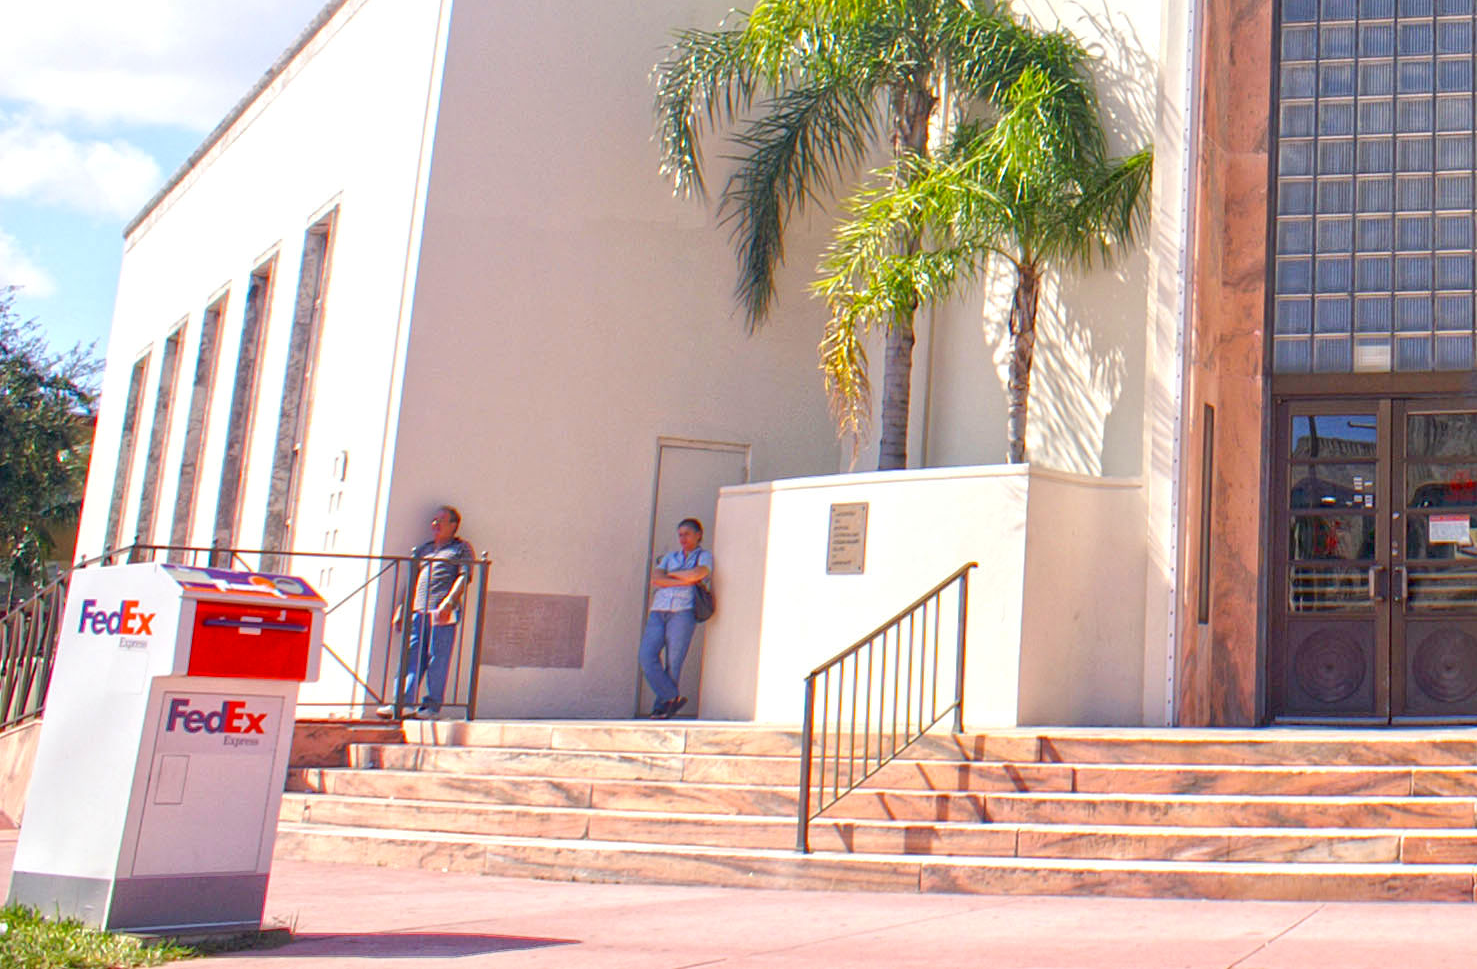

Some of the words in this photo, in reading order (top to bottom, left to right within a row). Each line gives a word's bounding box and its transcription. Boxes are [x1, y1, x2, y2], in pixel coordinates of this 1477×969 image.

[78, 599, 156, 635] FedEx
[119, 637, 147, 649] Express
[165, 698, 267, 734] FedEx
[224, 735, 259, 747] Express
